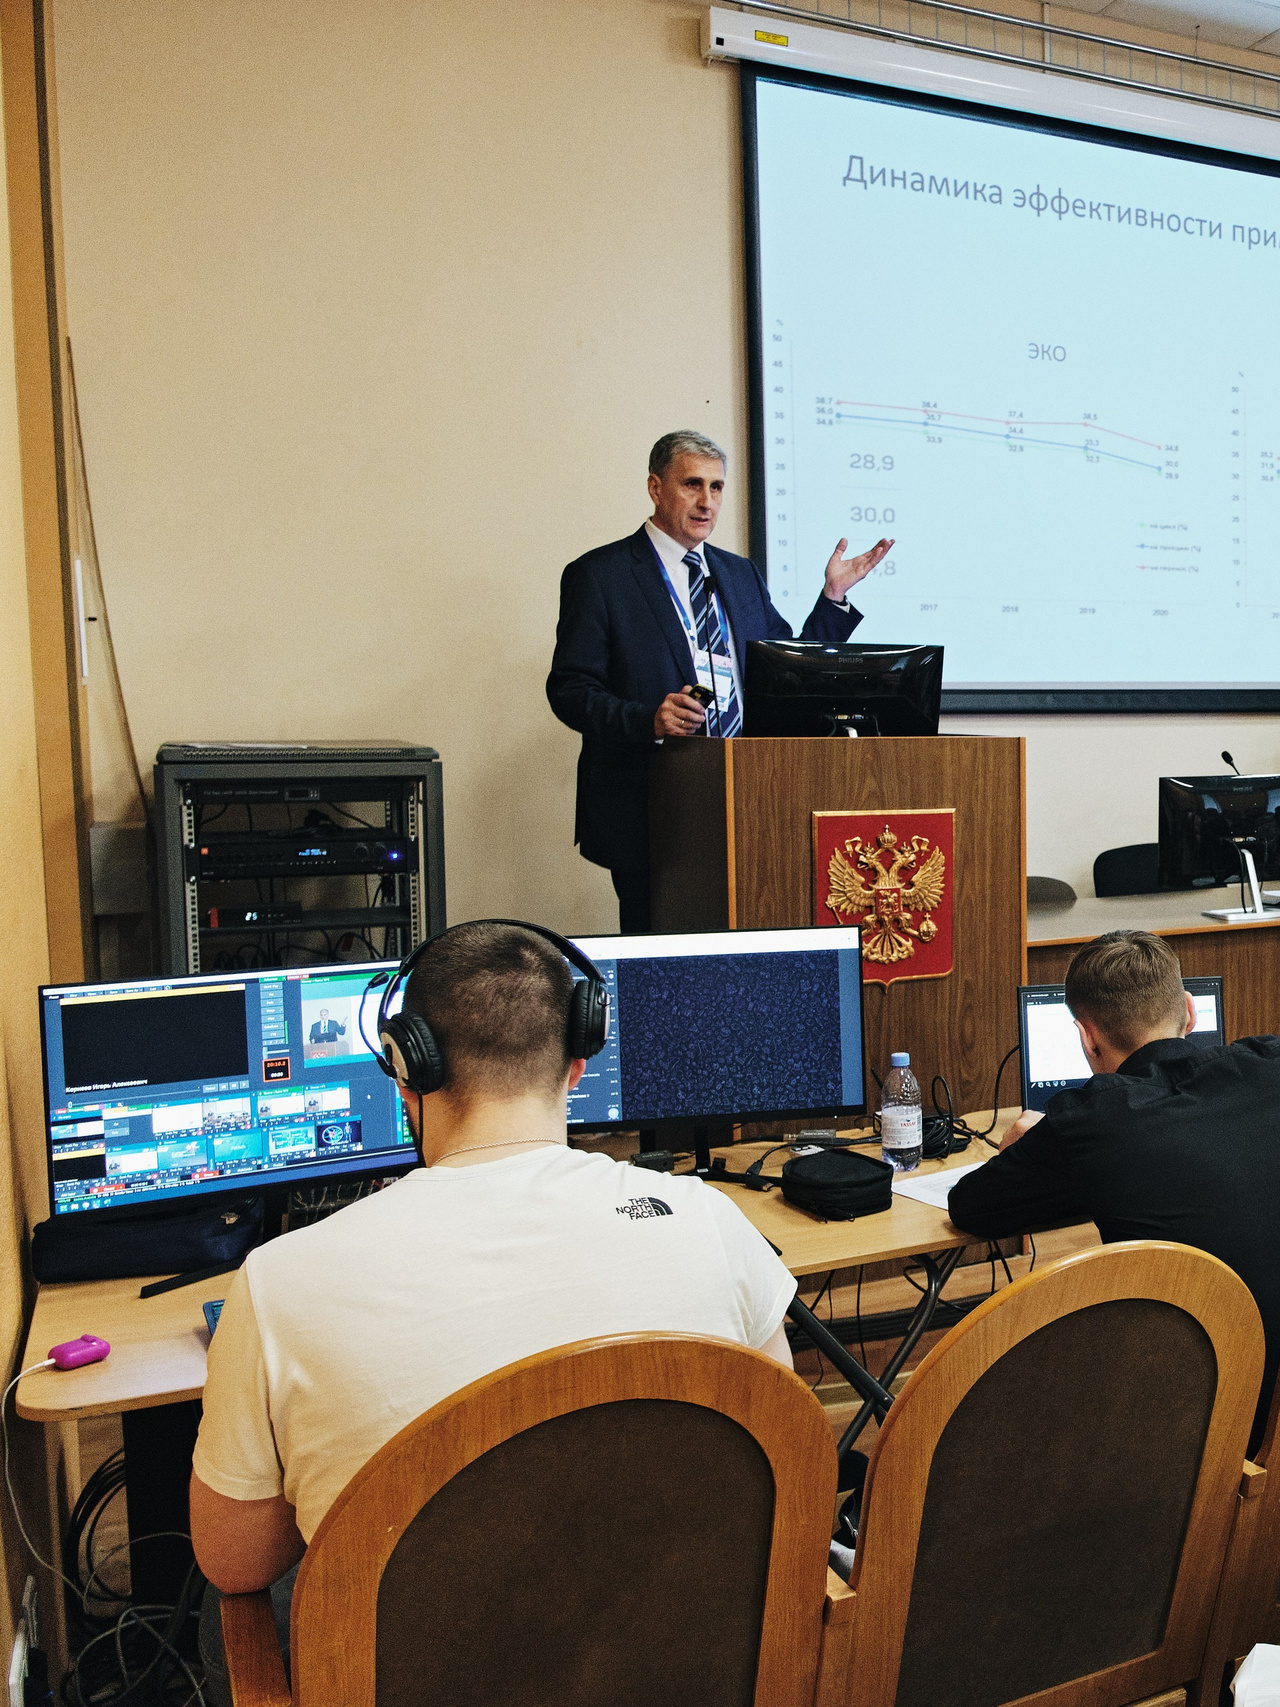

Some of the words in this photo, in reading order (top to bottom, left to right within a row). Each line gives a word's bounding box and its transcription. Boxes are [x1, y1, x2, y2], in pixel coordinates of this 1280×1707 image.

[843, 155, 1002, 205] Динамика
[1012, 184, 1222, 239] эффективности
[772, 334, 782, 342] 50
[1028, 342, 1066, 362] ЭКО
[772, 360, 783, 368] 45
[775, 437, 785, 445] 30
[850, 453, 895, 472] 28,9
[850, 507, 896, 525] 30,0
[628, 1197, 649, 1206] THE
[616, 1203, 653, 1214] NORTH
[629, 1210, 655, 1220] FACE
